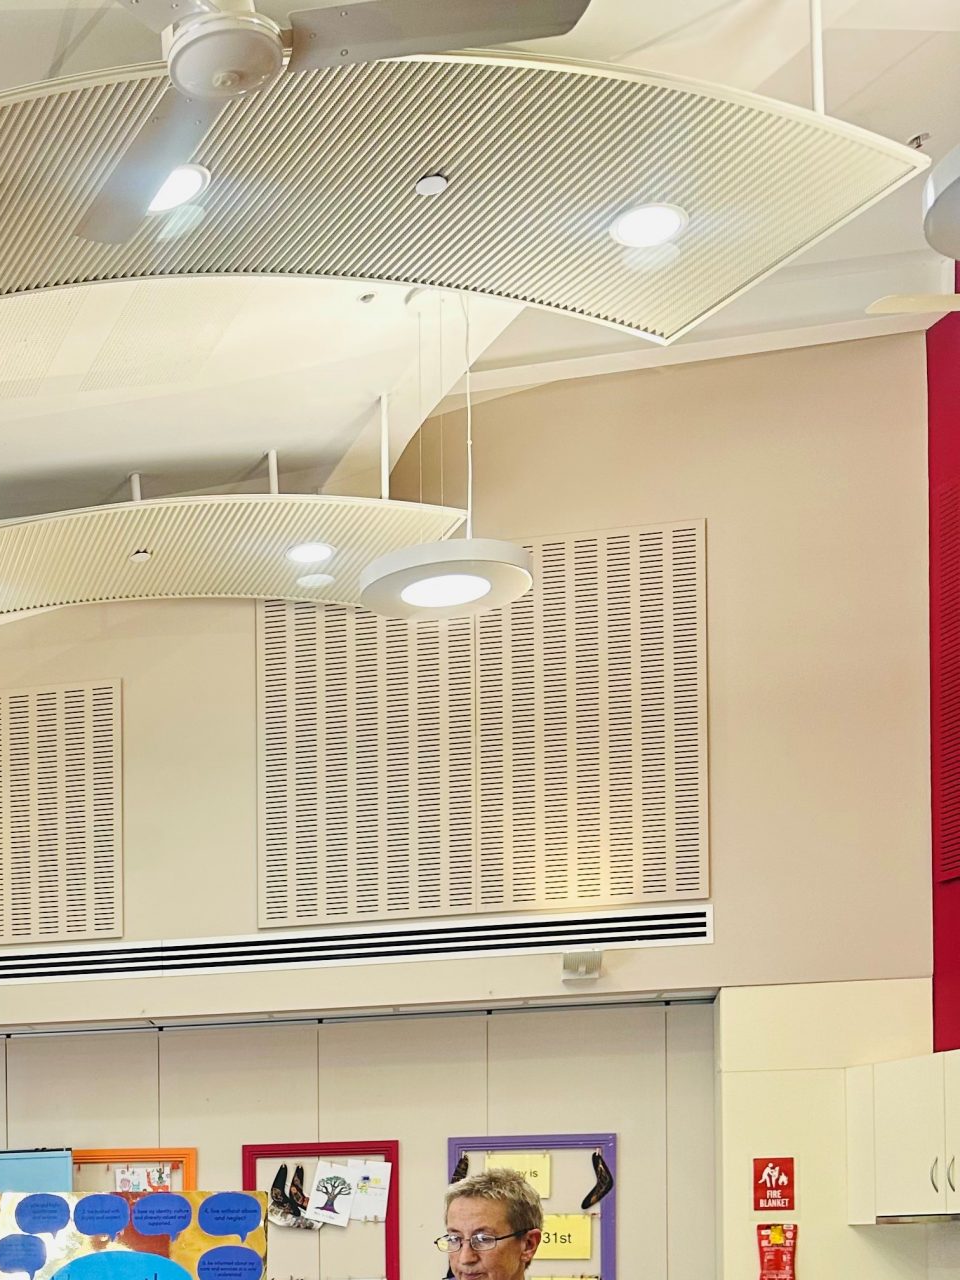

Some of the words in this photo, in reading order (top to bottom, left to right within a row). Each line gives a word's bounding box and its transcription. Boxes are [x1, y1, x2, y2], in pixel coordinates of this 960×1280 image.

[529, 1169, 538, 1178] is
[766, 1189, 782, 1199] FIRE
[759, 1198, 789, 1208] BLANKET
[542, 1232, 572, 1244] 31st
